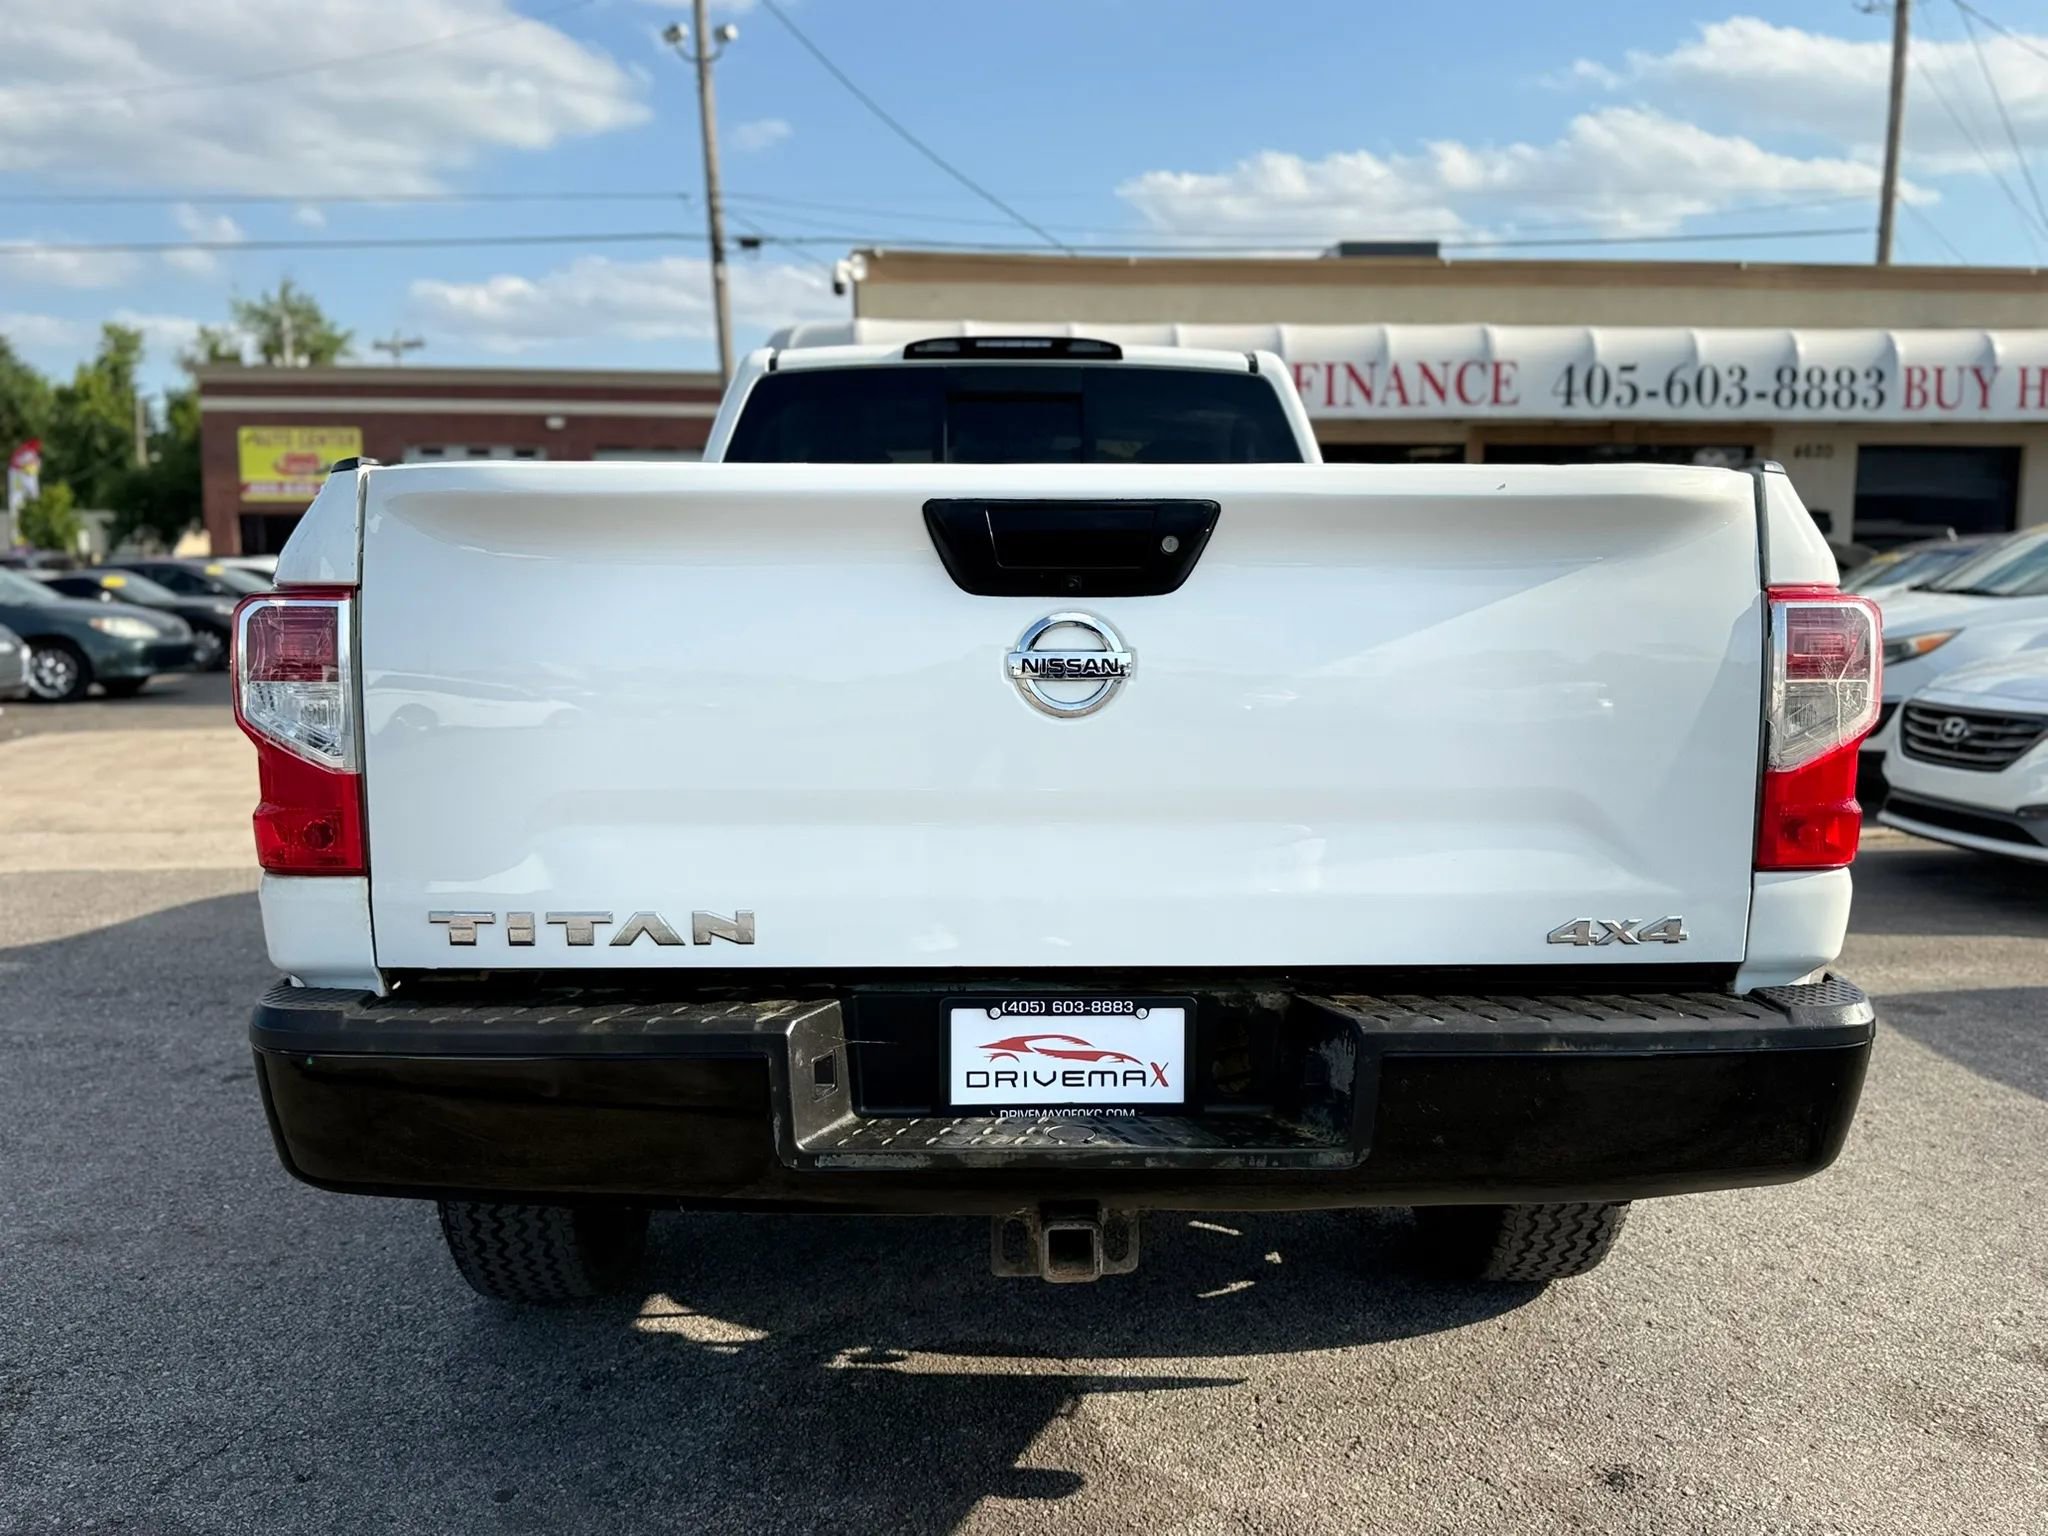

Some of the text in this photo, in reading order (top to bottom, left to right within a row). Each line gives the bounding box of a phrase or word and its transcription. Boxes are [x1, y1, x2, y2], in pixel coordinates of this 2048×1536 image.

[1292, 360, 1520, 407] FINANCE
[1550, 362, 1887, 411] 405-603-8883
[1902, 366, 2000, 410] BUY
[1020, 657, 1119, 675] NISSAN
[428, 910, 755, 946] TITAN
[1001, 1000, 1134, 1014] (405) 603-8883
[966, 1061, 1169, 1088] DRIVEMAX
[1000, 1109, 1136, 1118] DRIVEMAXOFOKCCOM
